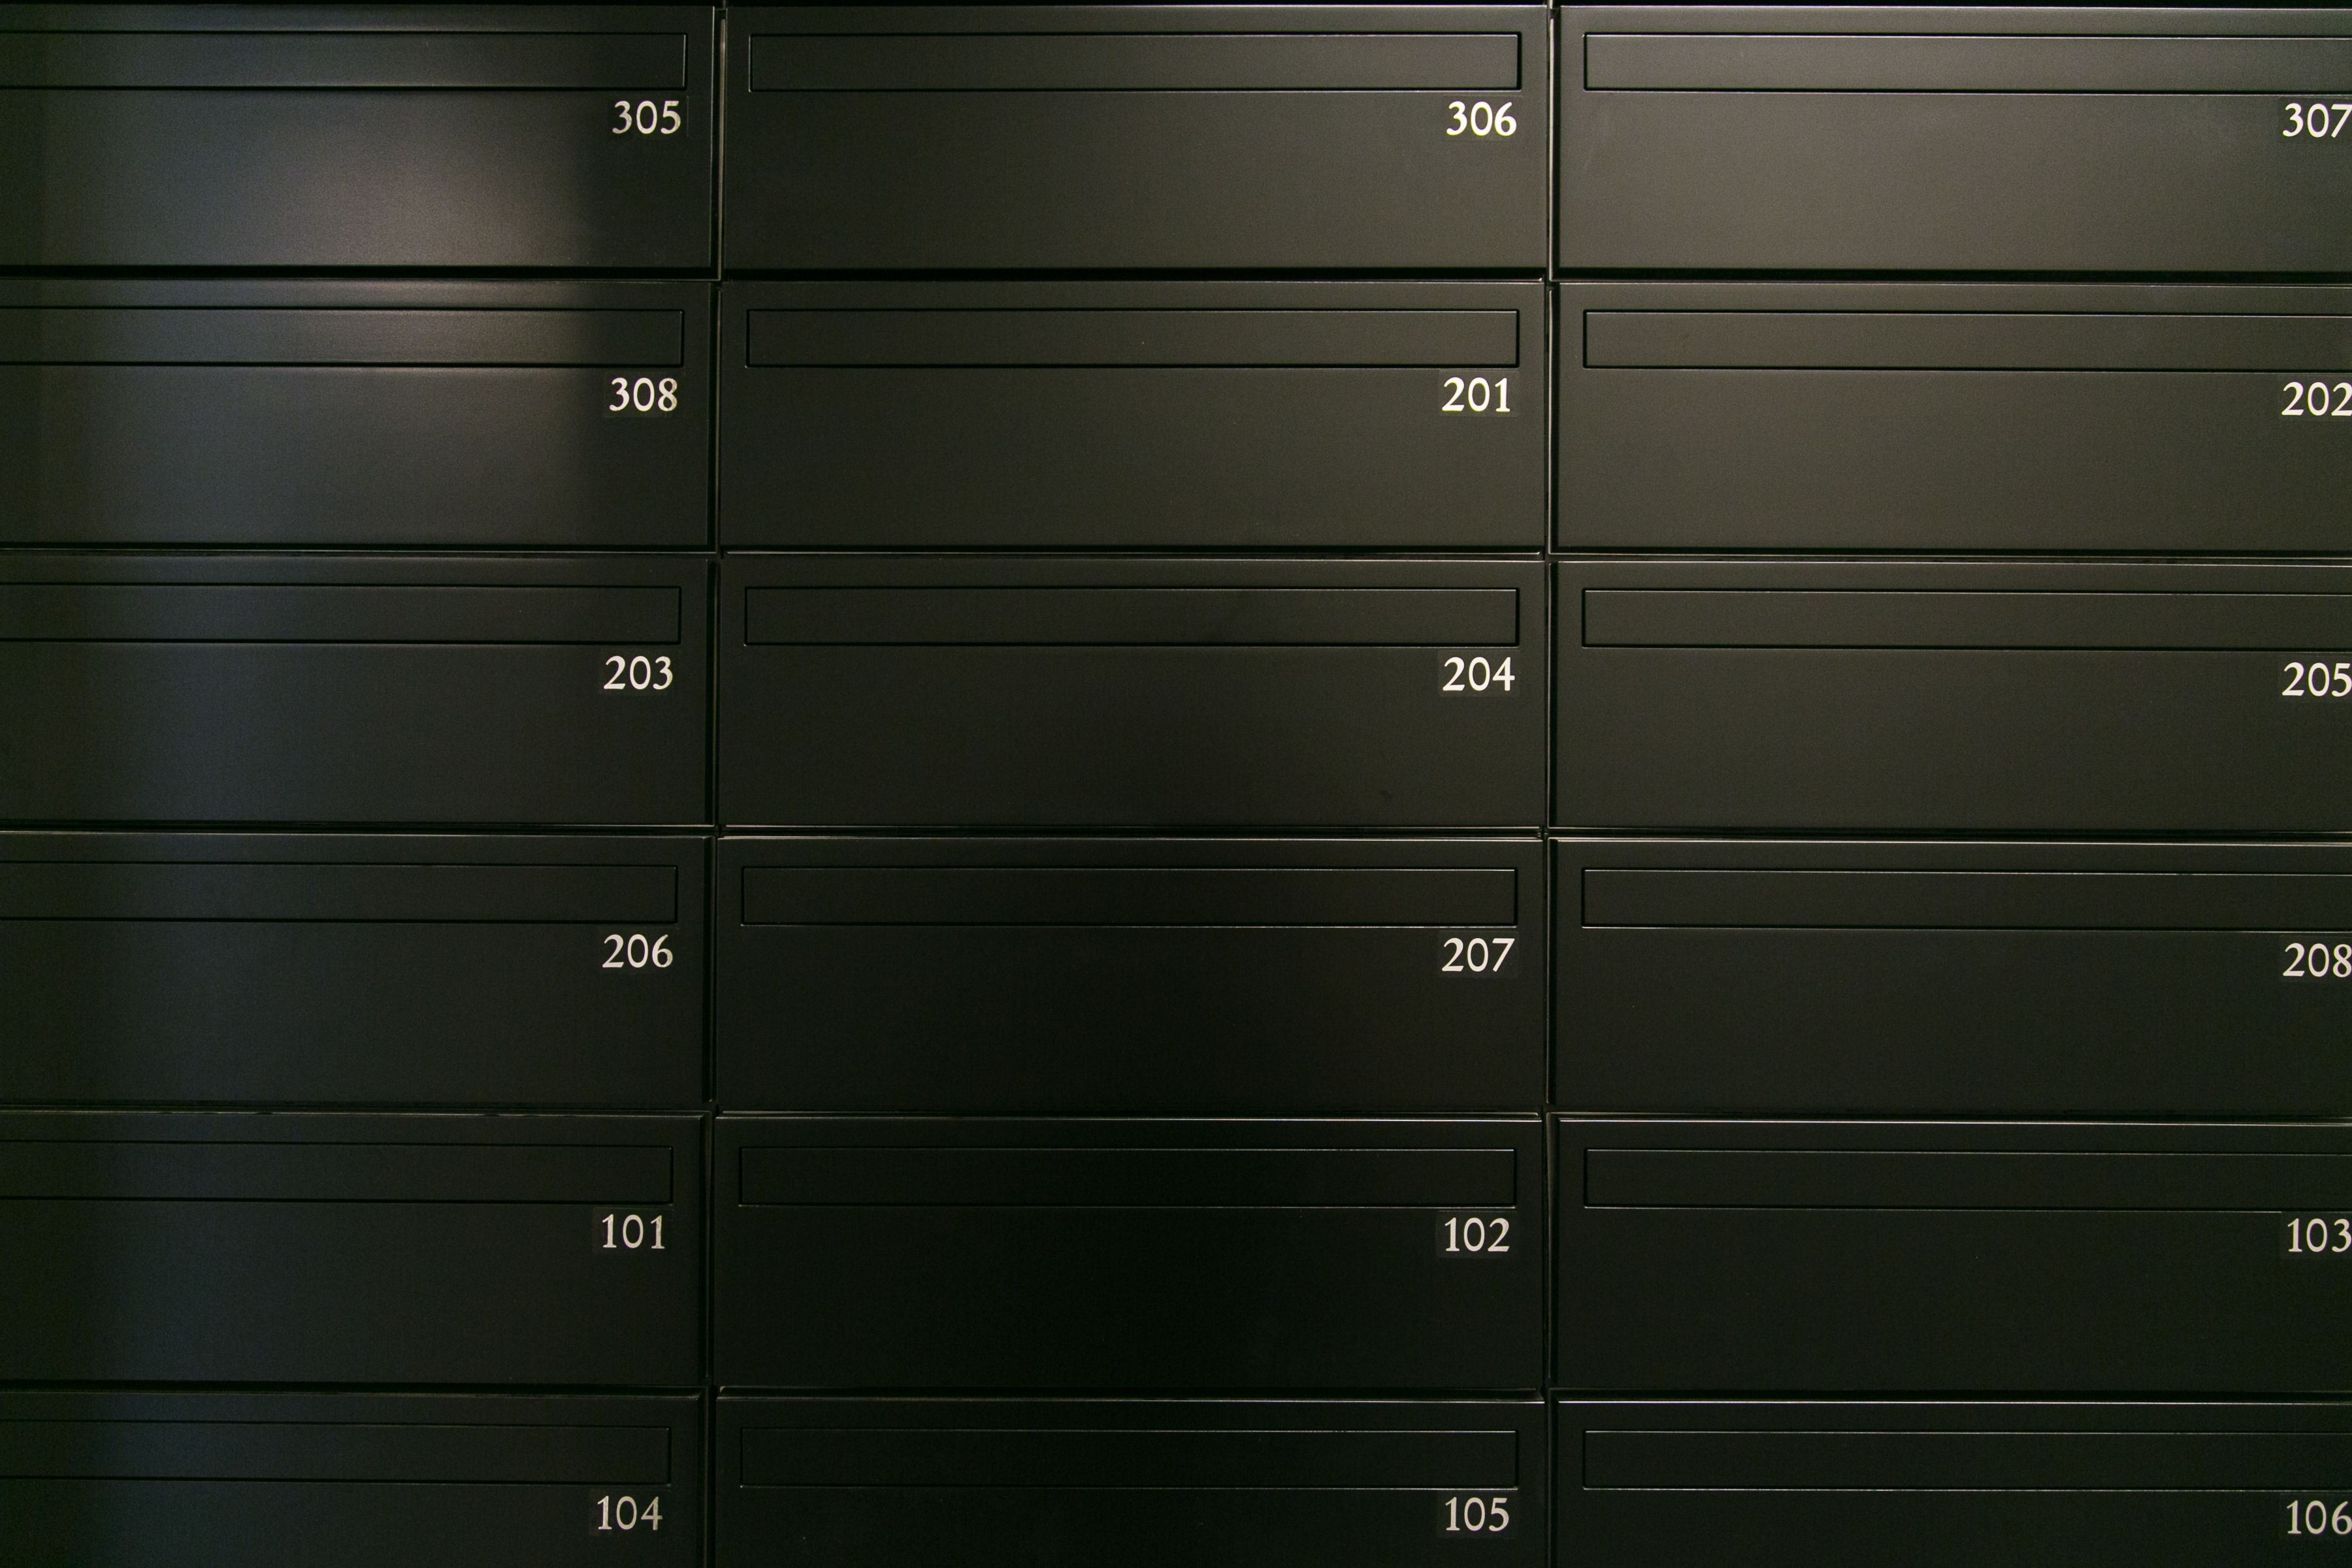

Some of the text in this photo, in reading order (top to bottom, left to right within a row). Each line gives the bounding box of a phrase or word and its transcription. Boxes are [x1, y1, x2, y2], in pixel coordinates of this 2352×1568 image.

[613, 101, 681, 134] 305
[1446, 101, 1516, 136] 306
[2283, 103, 2352, 137] 307
[610, 378, 677, 411] 308
[1442, 377, 1510, 412] 201
[2281, 382, 2352, 416] 202
[604, 656, 672, 689] 203
[1443, 657, 1514, 691] 204
[2282, 662, 2352, 696] 205
[602, 934, 672, 968] 206
[1442, 938, 1514, 972] 207
[2283, 943, 2352, 977] 208
[602, 1214, 664, 1249] 101
[1445, 1218, 1509, 1252] 102
[2288, 1218, 2351, 1252] 103
[598, 1496, 662, 1530] 104
[1446, 1497, 1509, 1531] 105
[2287, 1500, 2352, 1534] 106
